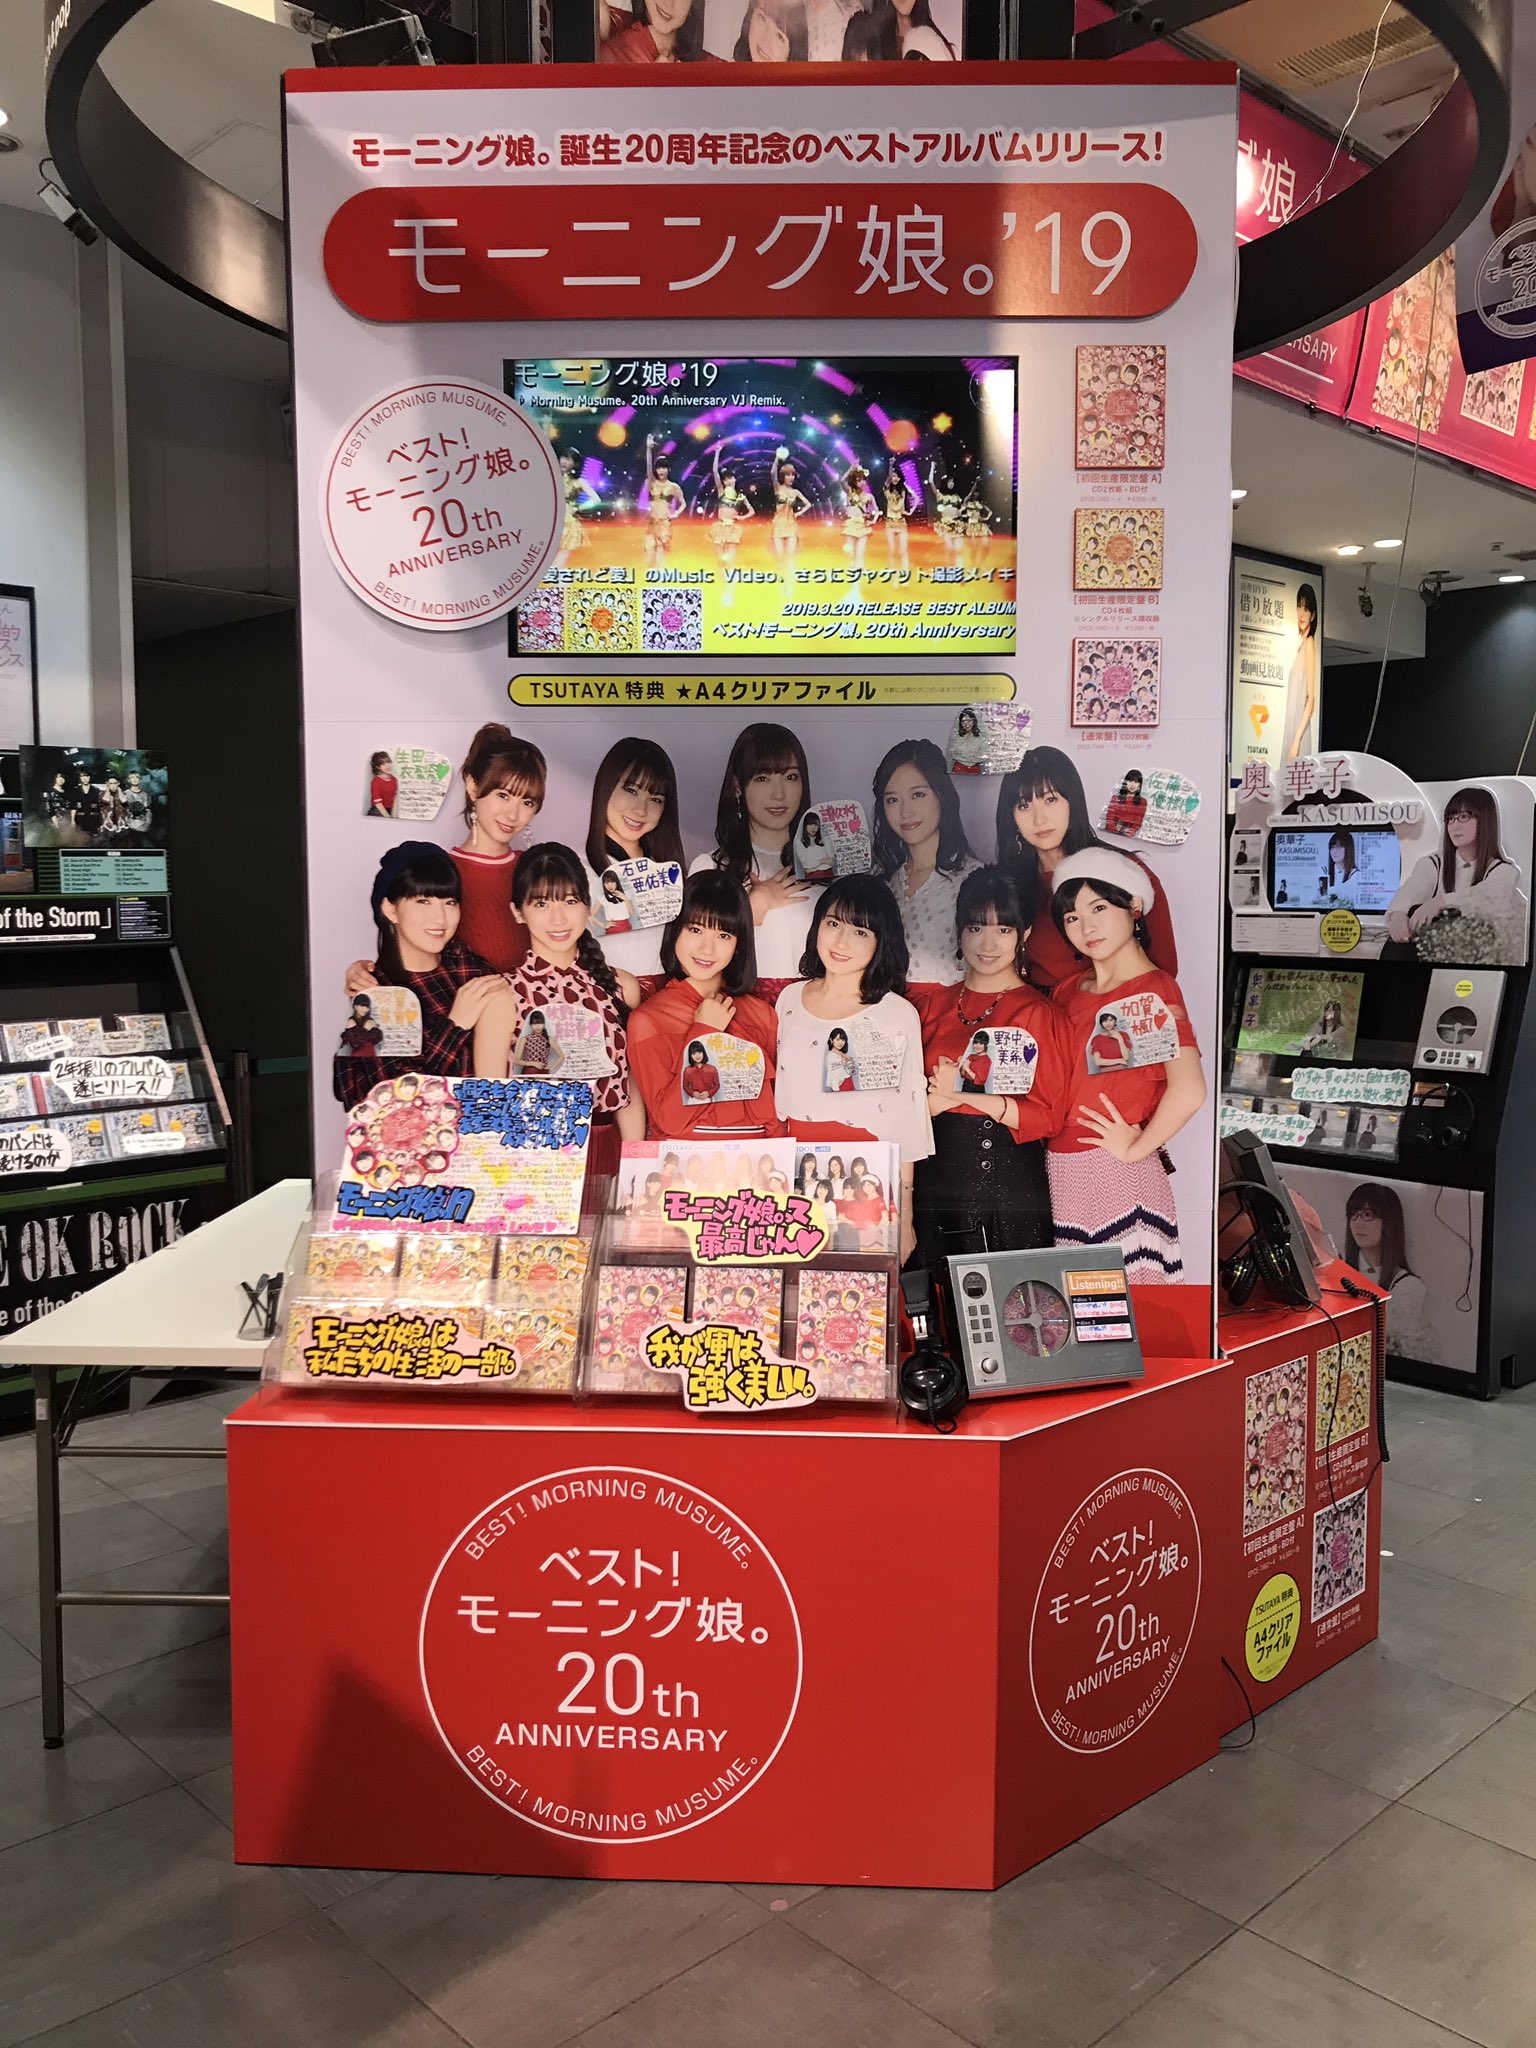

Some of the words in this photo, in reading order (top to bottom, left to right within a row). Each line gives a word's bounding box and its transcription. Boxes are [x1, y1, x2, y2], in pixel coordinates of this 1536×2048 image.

[531, 395, 573, 408] Morning
[631, 395, 658, 406] 20th
[662, 395, 727, 408] Anniversary
[731, 395, 746, 406] VJ
[750, 395, 786, 406] Remix.
[341, 425, 372, 467] BEST!
[371, 391, 437, 427] MORNING
[387, 427, 469, 463] ベスト!
[346, 447, 530, 512] モーニング娘。
[413, 498, 502, 547] 20th
[388, 529, 522, 577] ANNIVERSARY
[375, 581, 416, 611] BEST!
[421, 594, 491, 615] MORNING
[856, 602, 922, 616] RELEASE
[926, 602, 965, 616] BEST
[966, 602, 1016, 616] ALBUM
[1239, 593, 1286, 620] 借り放題
[864, 623, 907, 638] 20th
[909, 622, 1016, 640] Anniversary
[1240, 659, 1284, 681] 動画見放題
[530, 682, 619, 699] TSUTAYA
[625, 681, 665, 700] 特典
[1301, 804, 1420, 823] KASUMISOU
[619, 859, 648, 877] 石田
[631, 868, 671, 893] 亜佑美
[15, 906, 44, 928] the
[1120, 995, 1154, 1017] 加賀
[994, 1030, 1022, 1046] 野中
[998, 1046, 1022, 1066] 美希
[55, 1058, 166, 1079] 2年振りのアルバム
[21, 1215, 78, 1283] OK
[15, 1300, 33, 1324] of
[312, 1311, 460, 1349] モーニング娘。は
[648, 1323, 764, 1369] 我が軍は
[464, 1502, 527, 1561] BEST!
[531, 1478, 647, 1512] MORNING
[1054, 1517, 1086, 1569] BEST!
[1087, 1477, 1140, 1519] MORNING
[1089, 1520, 1154, 1564] ベスト!
[539, 1547, 680, 1588] ベスト!
[1049, 1542, 1189, 1625] モーニング娘。
[457, 1595, 769, 1645] モーニング娘。
[1256, 1596, 1281, 1617] TSUTAYA
[1096, 1603, 1160, 1664] 20th
[1253, 1612, 1294, 1648] A4クリア
[1256, 1631, 1292, 1664] ファイル
[557, 1651, 700, 1718] 20th
[1065, 1636, 1171, 1704] ANNIVERSARY
[495, 1722, 728, 1752] ANNIVERSARY
[1051, 1708, 1081, 1743] BEST!
[1081, 1714, 1135, 1746] MORNING
[466, 1744, 527, 1804] BEST!
[533, 1796, 647, 1832] MORNING
